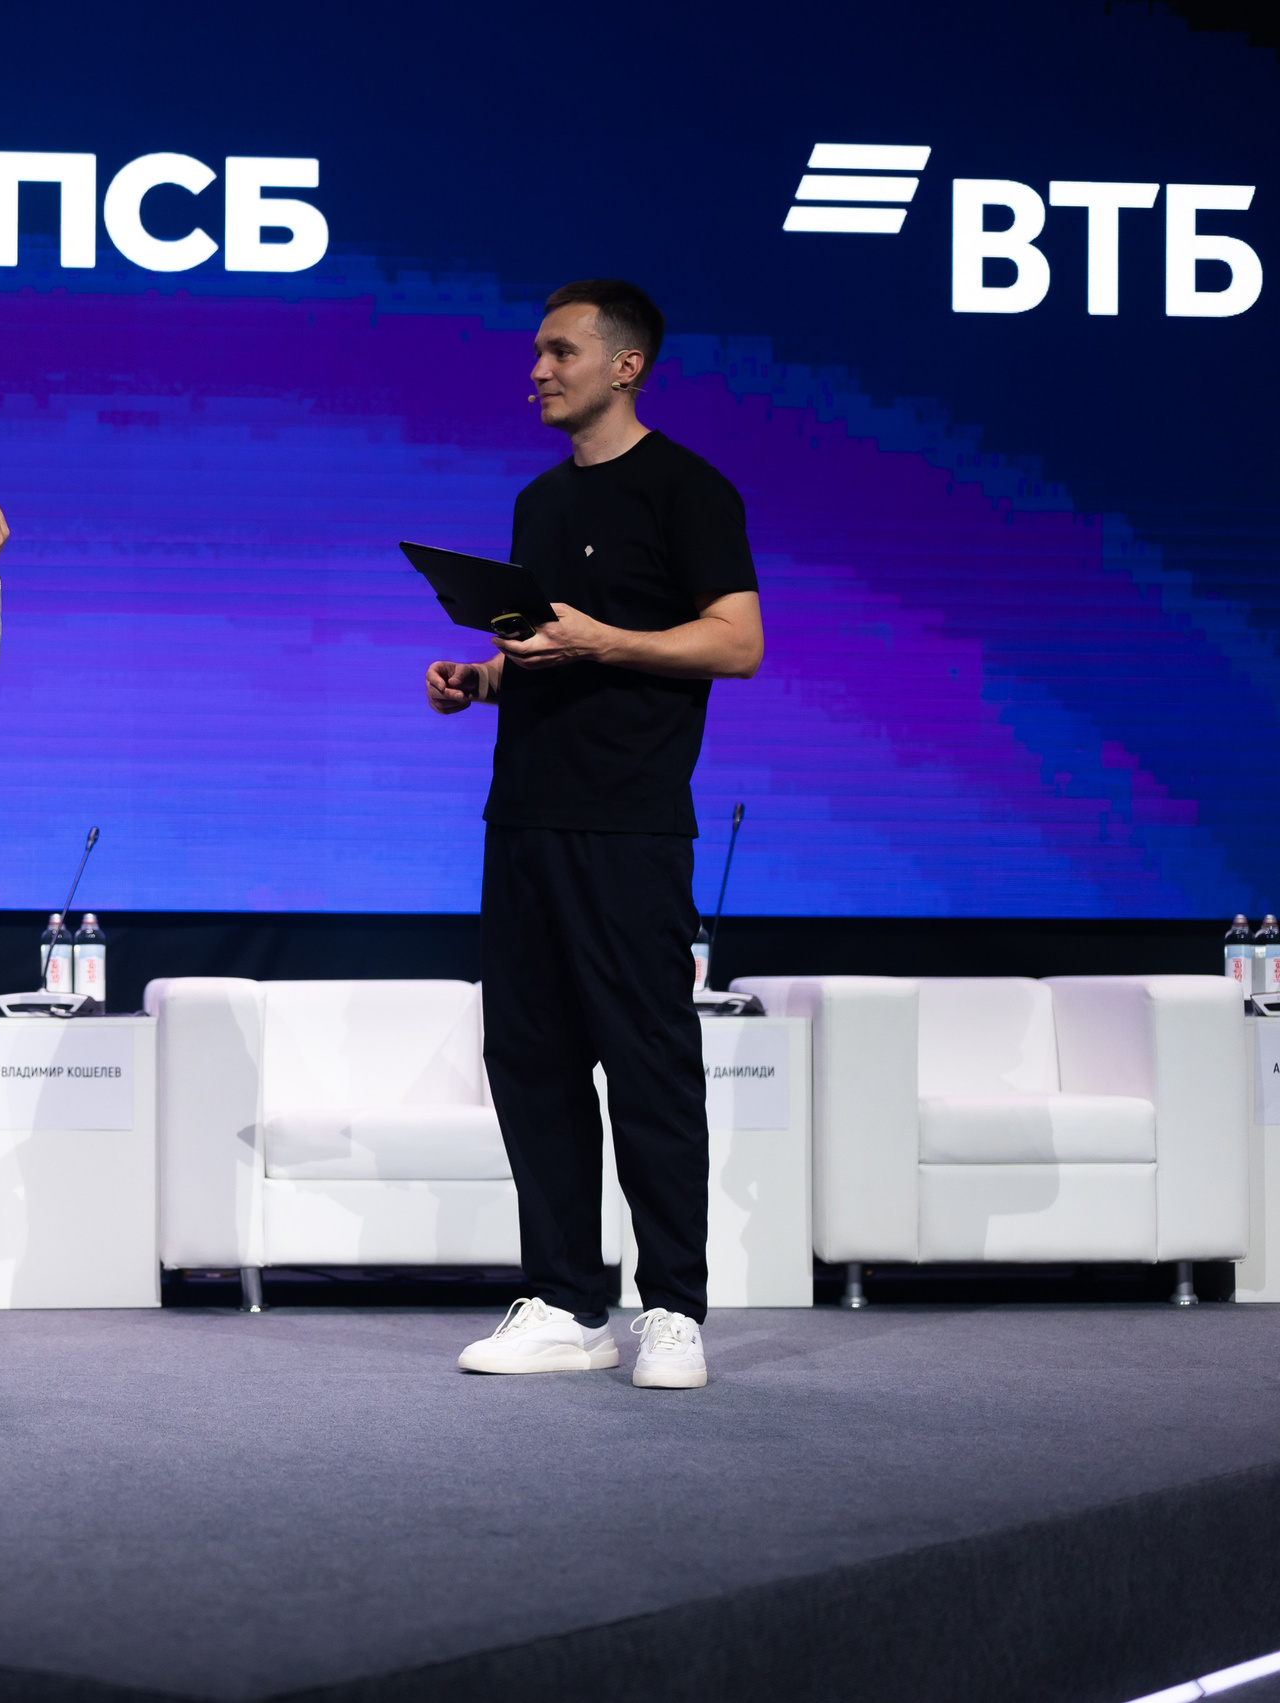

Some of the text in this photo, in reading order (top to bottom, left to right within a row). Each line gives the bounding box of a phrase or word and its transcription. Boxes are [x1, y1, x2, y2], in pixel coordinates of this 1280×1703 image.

[952, 178, 1263, 317] ВТБ
[1232, 958, 1243, 983] stel
[1, 1066, 122, 1079] ВЛАДИМИР КОШЕЛЕВ
[713, 1065, 775, 1079] ДАНИЛИДИ
